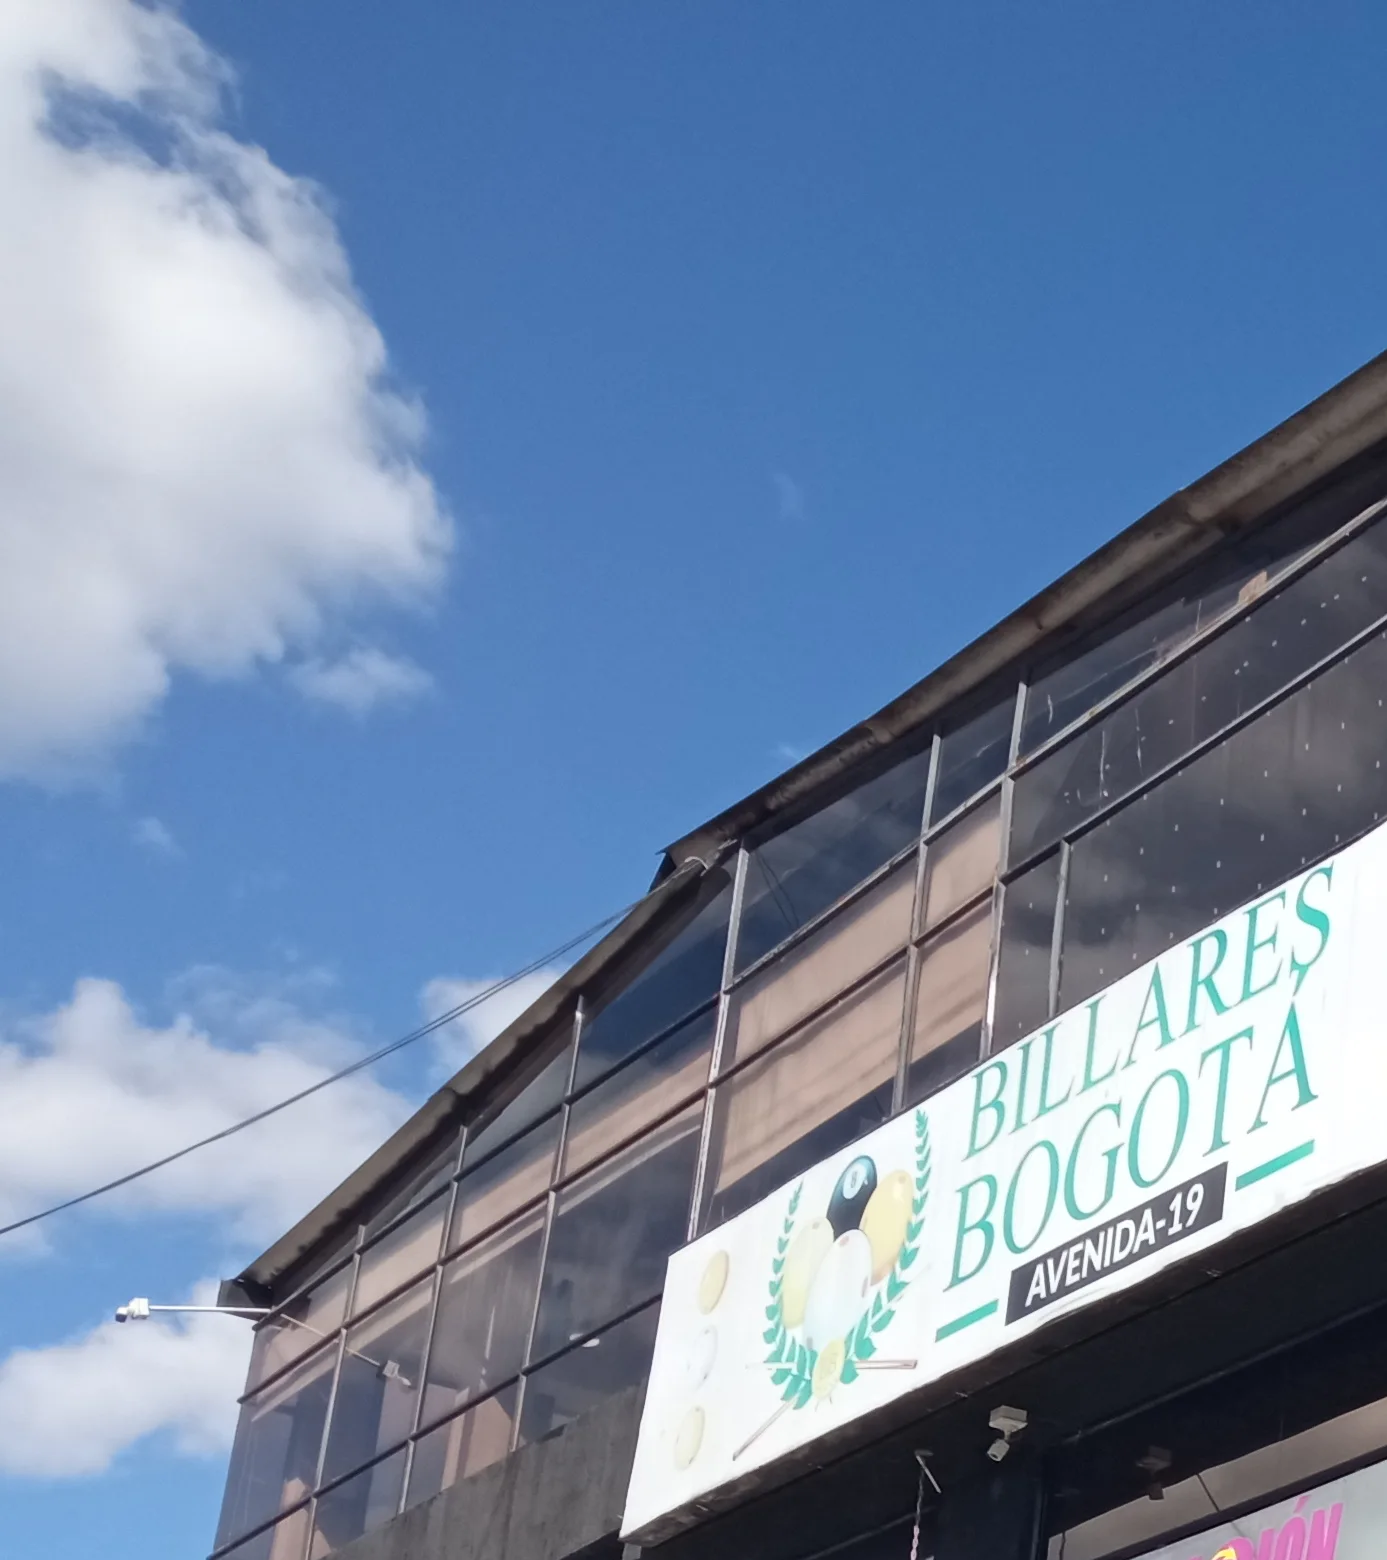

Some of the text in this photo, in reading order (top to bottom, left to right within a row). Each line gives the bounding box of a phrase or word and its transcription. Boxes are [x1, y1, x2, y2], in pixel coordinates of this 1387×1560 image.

[942, 966, 1319, 1293] BOGOTÁ
[963, 860, 1336, 1163] BILLARES
[1024, 1183, 1206, 1308] AVENIDA-19
